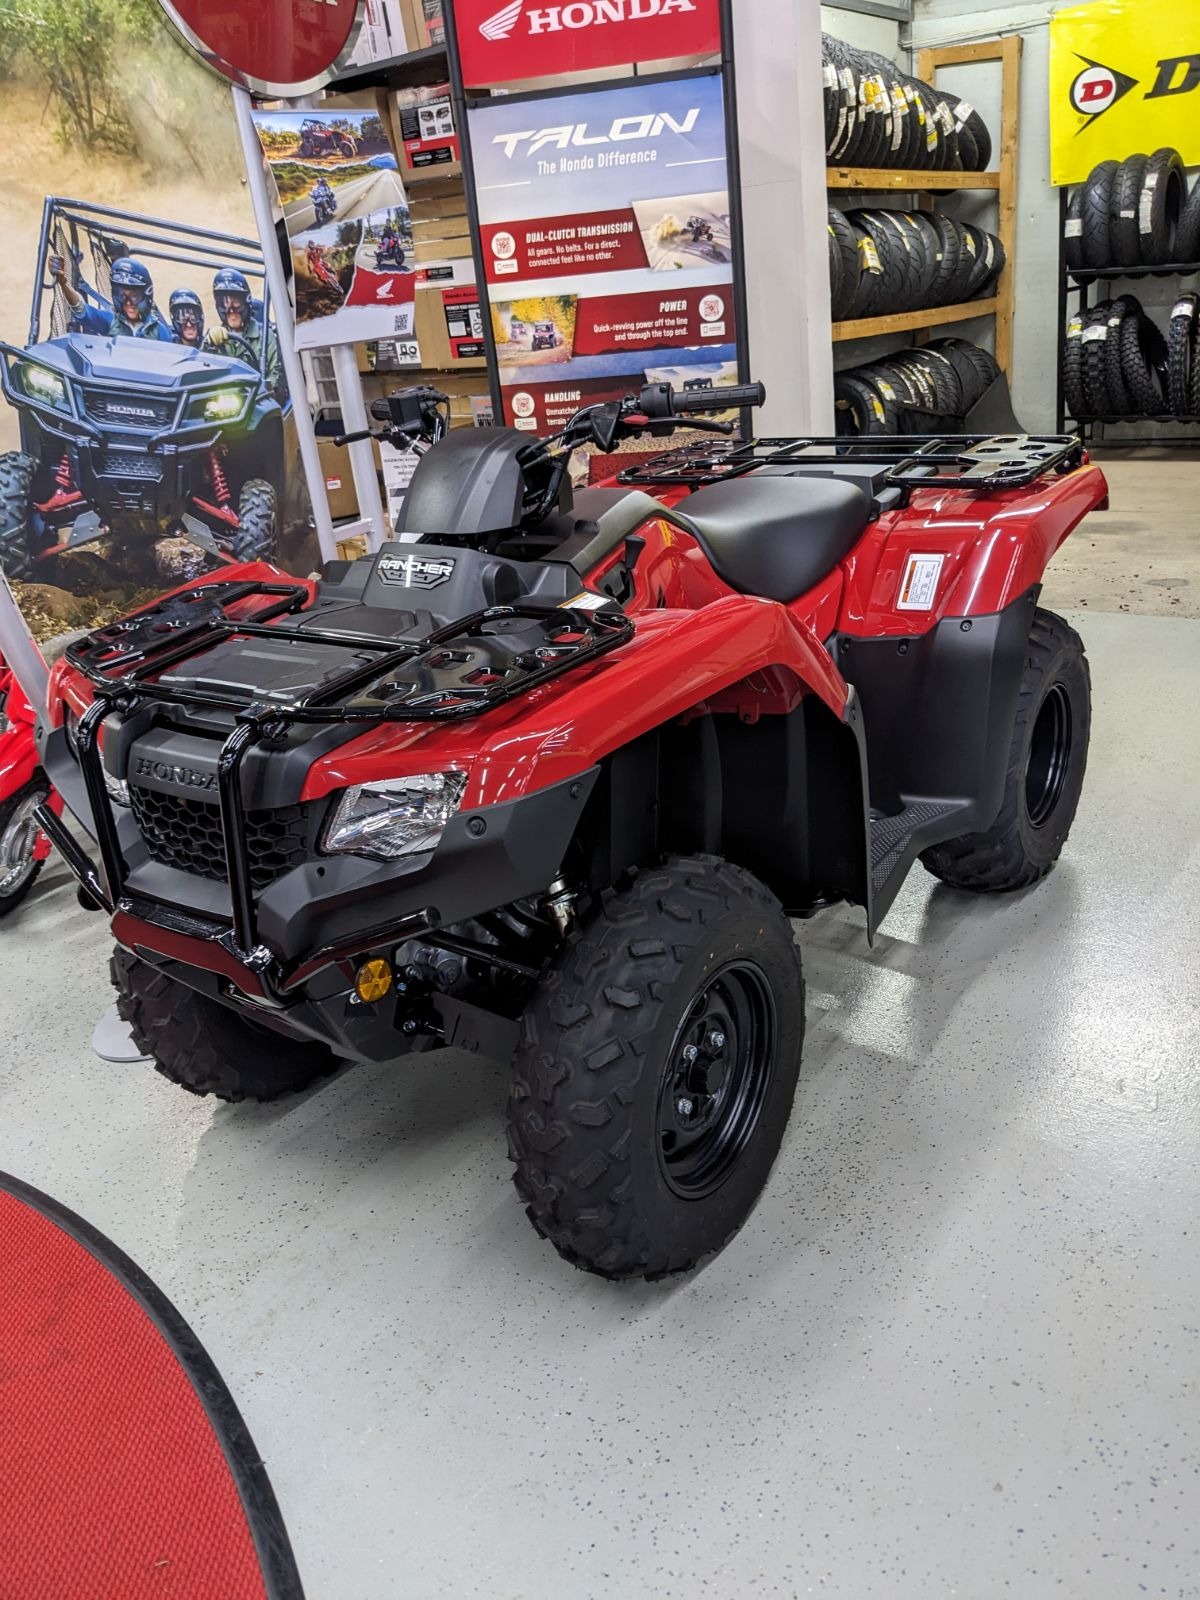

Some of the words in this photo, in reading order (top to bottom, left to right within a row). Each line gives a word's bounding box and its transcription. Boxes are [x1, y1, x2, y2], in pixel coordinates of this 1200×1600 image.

[492, 108, 700, 159] TALON
[537, 161, 556, 175] The
[560, 157, 594, 173] Honda
[598, 150, 657, 167] Difference
[526, 228, 575, 244] DUAL-CLUTCH
[577, 222, 633, 237] TRANSMISSION
[556, 245, 565, 253] No
[584, 242, 594, 250] For
[528, 256, 560, 267] connected
[561, 255, 573, 263] feel
[574, 253, 585, 262] like
[660, 300, 687, 312] POWER
[593, 322, 635, 333] Quick-revving
[636, 321, 653, 330] power
[665, 318, 675, 326] the
[614, 332, 626, 341] and
[627, 330, 651, 340] through
[652, 330, 662, 338] the
[663, 330, 673, 338] top
[545, 391, 581, 403] HANDLING
[107, 403, 156, 417] HONDA
[546, 406, 579, 416] Unmatched
[547, 418, 566, 426] terrain
[378, 559, 453, 576] RANCHER
[136, 758, 219, 793] HONDA
